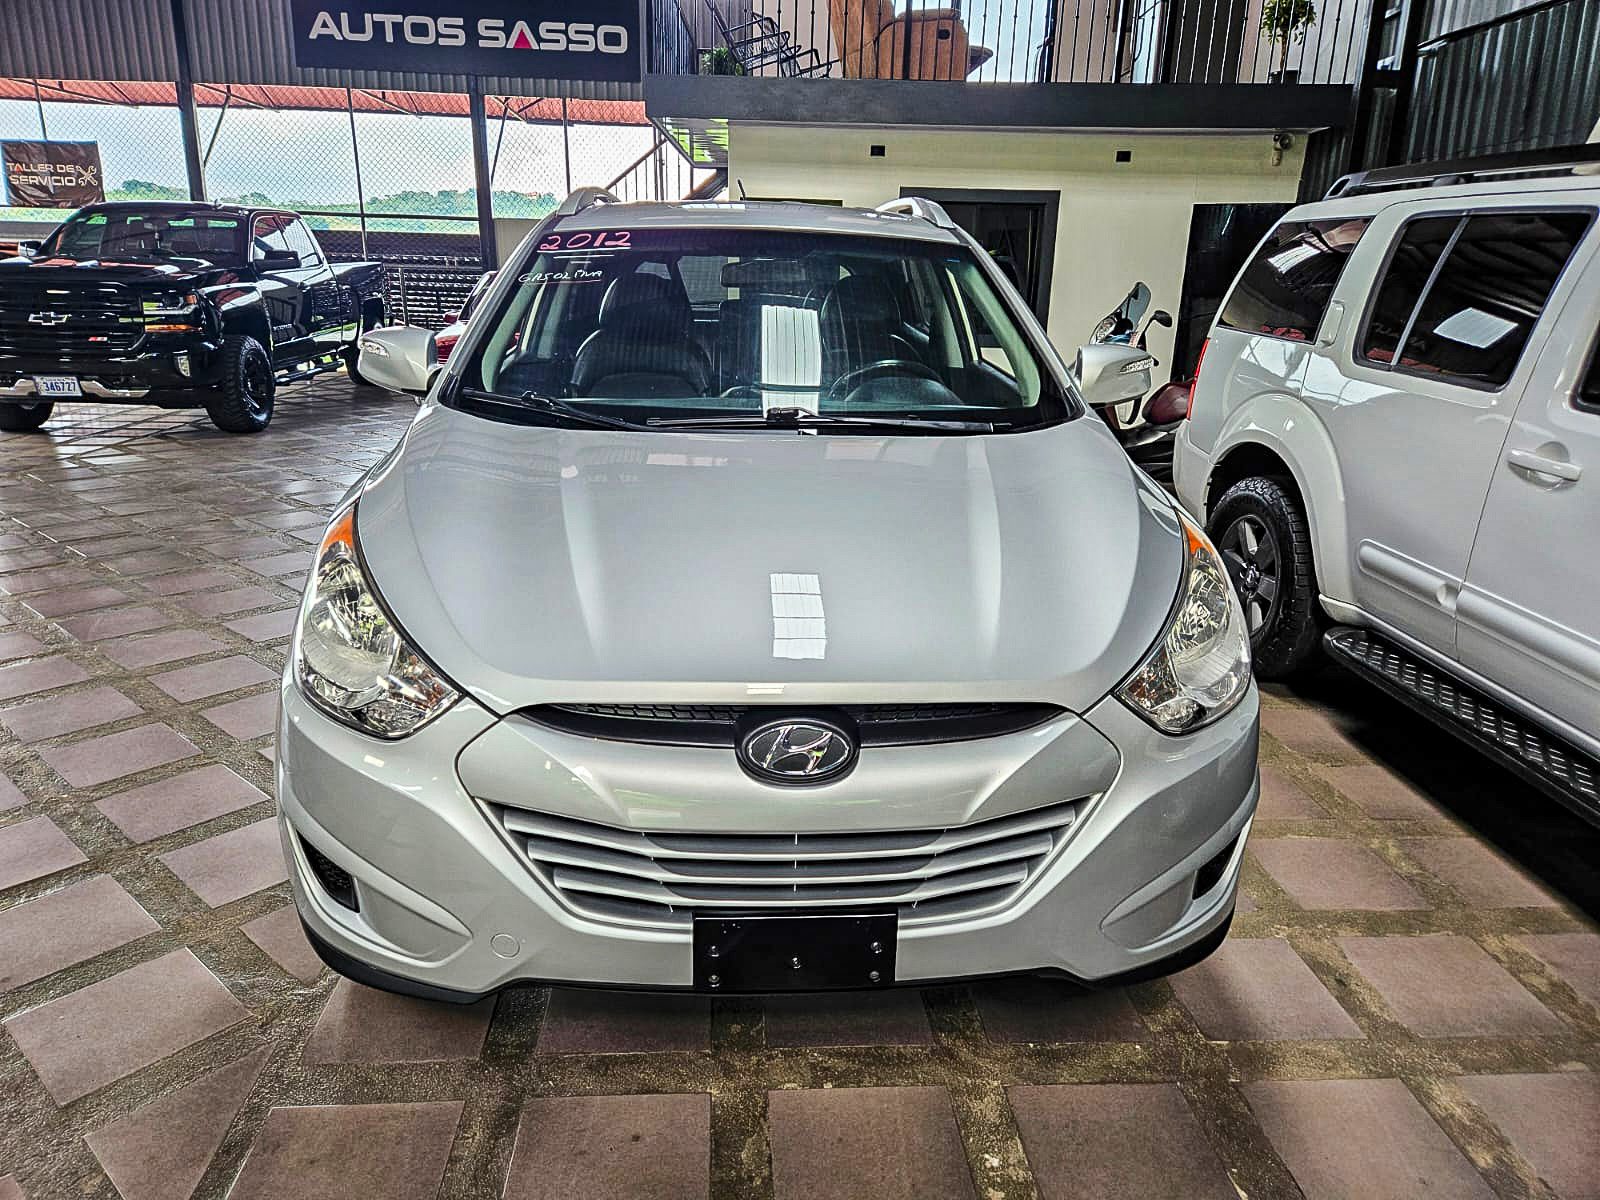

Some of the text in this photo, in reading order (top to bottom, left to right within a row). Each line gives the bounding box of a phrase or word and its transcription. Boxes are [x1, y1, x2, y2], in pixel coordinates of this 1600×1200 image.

[309, 11, 628, 53] AUTOS SASSO
[6, 162, 75, 173] TALLER DE
[9, 175, 76, 187] SERVICIO
[540, 231, 631, 250] 2012
